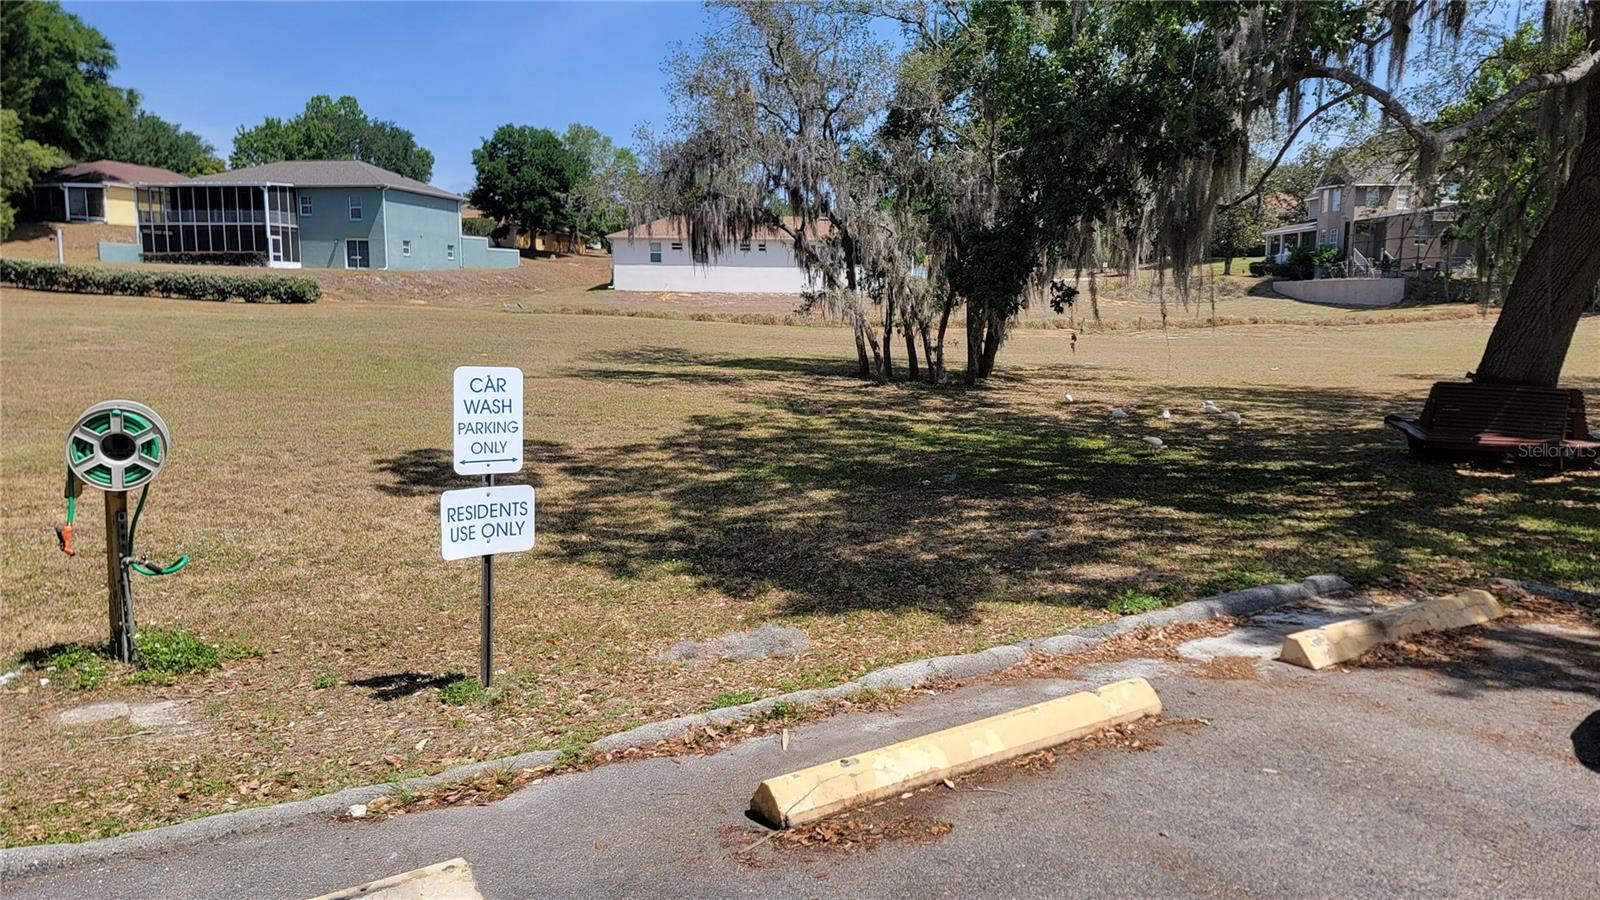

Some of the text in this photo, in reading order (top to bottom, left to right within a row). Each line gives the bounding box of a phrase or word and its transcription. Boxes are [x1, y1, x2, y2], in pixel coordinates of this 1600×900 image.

[469, 377, 507, 393] CAR
[463, 399, 512, 415] WASH
[458, 420, 519, 435] PARKING
[470, 441, 508, 455] ONLY
[447, 501, 528, 523] RESIDENTS
[450, 520, 526, 543] USE ONLY
